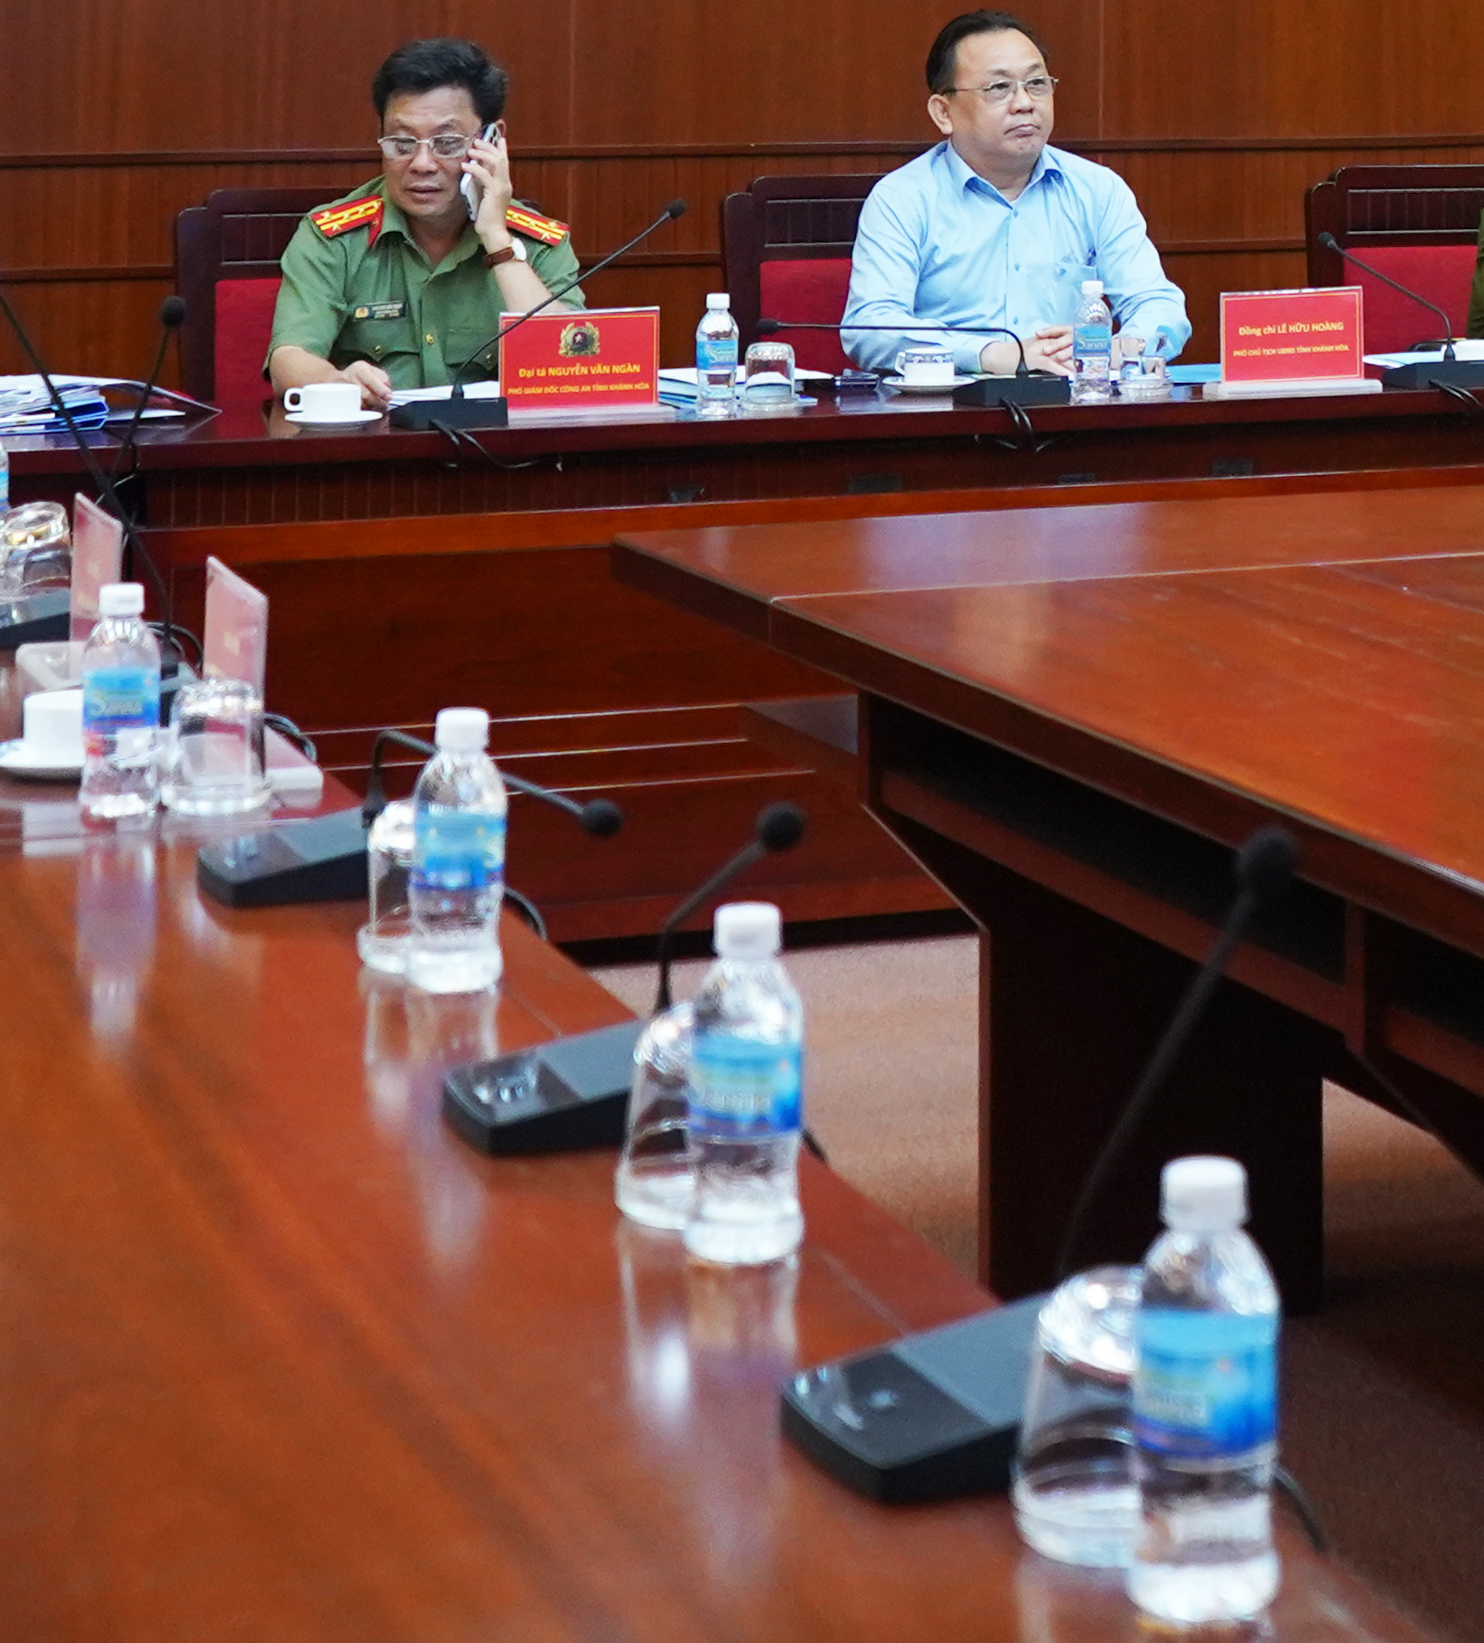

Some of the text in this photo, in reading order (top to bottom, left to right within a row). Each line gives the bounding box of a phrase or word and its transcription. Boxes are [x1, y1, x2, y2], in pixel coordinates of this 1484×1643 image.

[1239, 321, 1343, 337] Đồng chí LÊ HỮU HOÀNG
[519, 363, 640, 378] Đại tá NGUYỄN VĂN NGÀN
